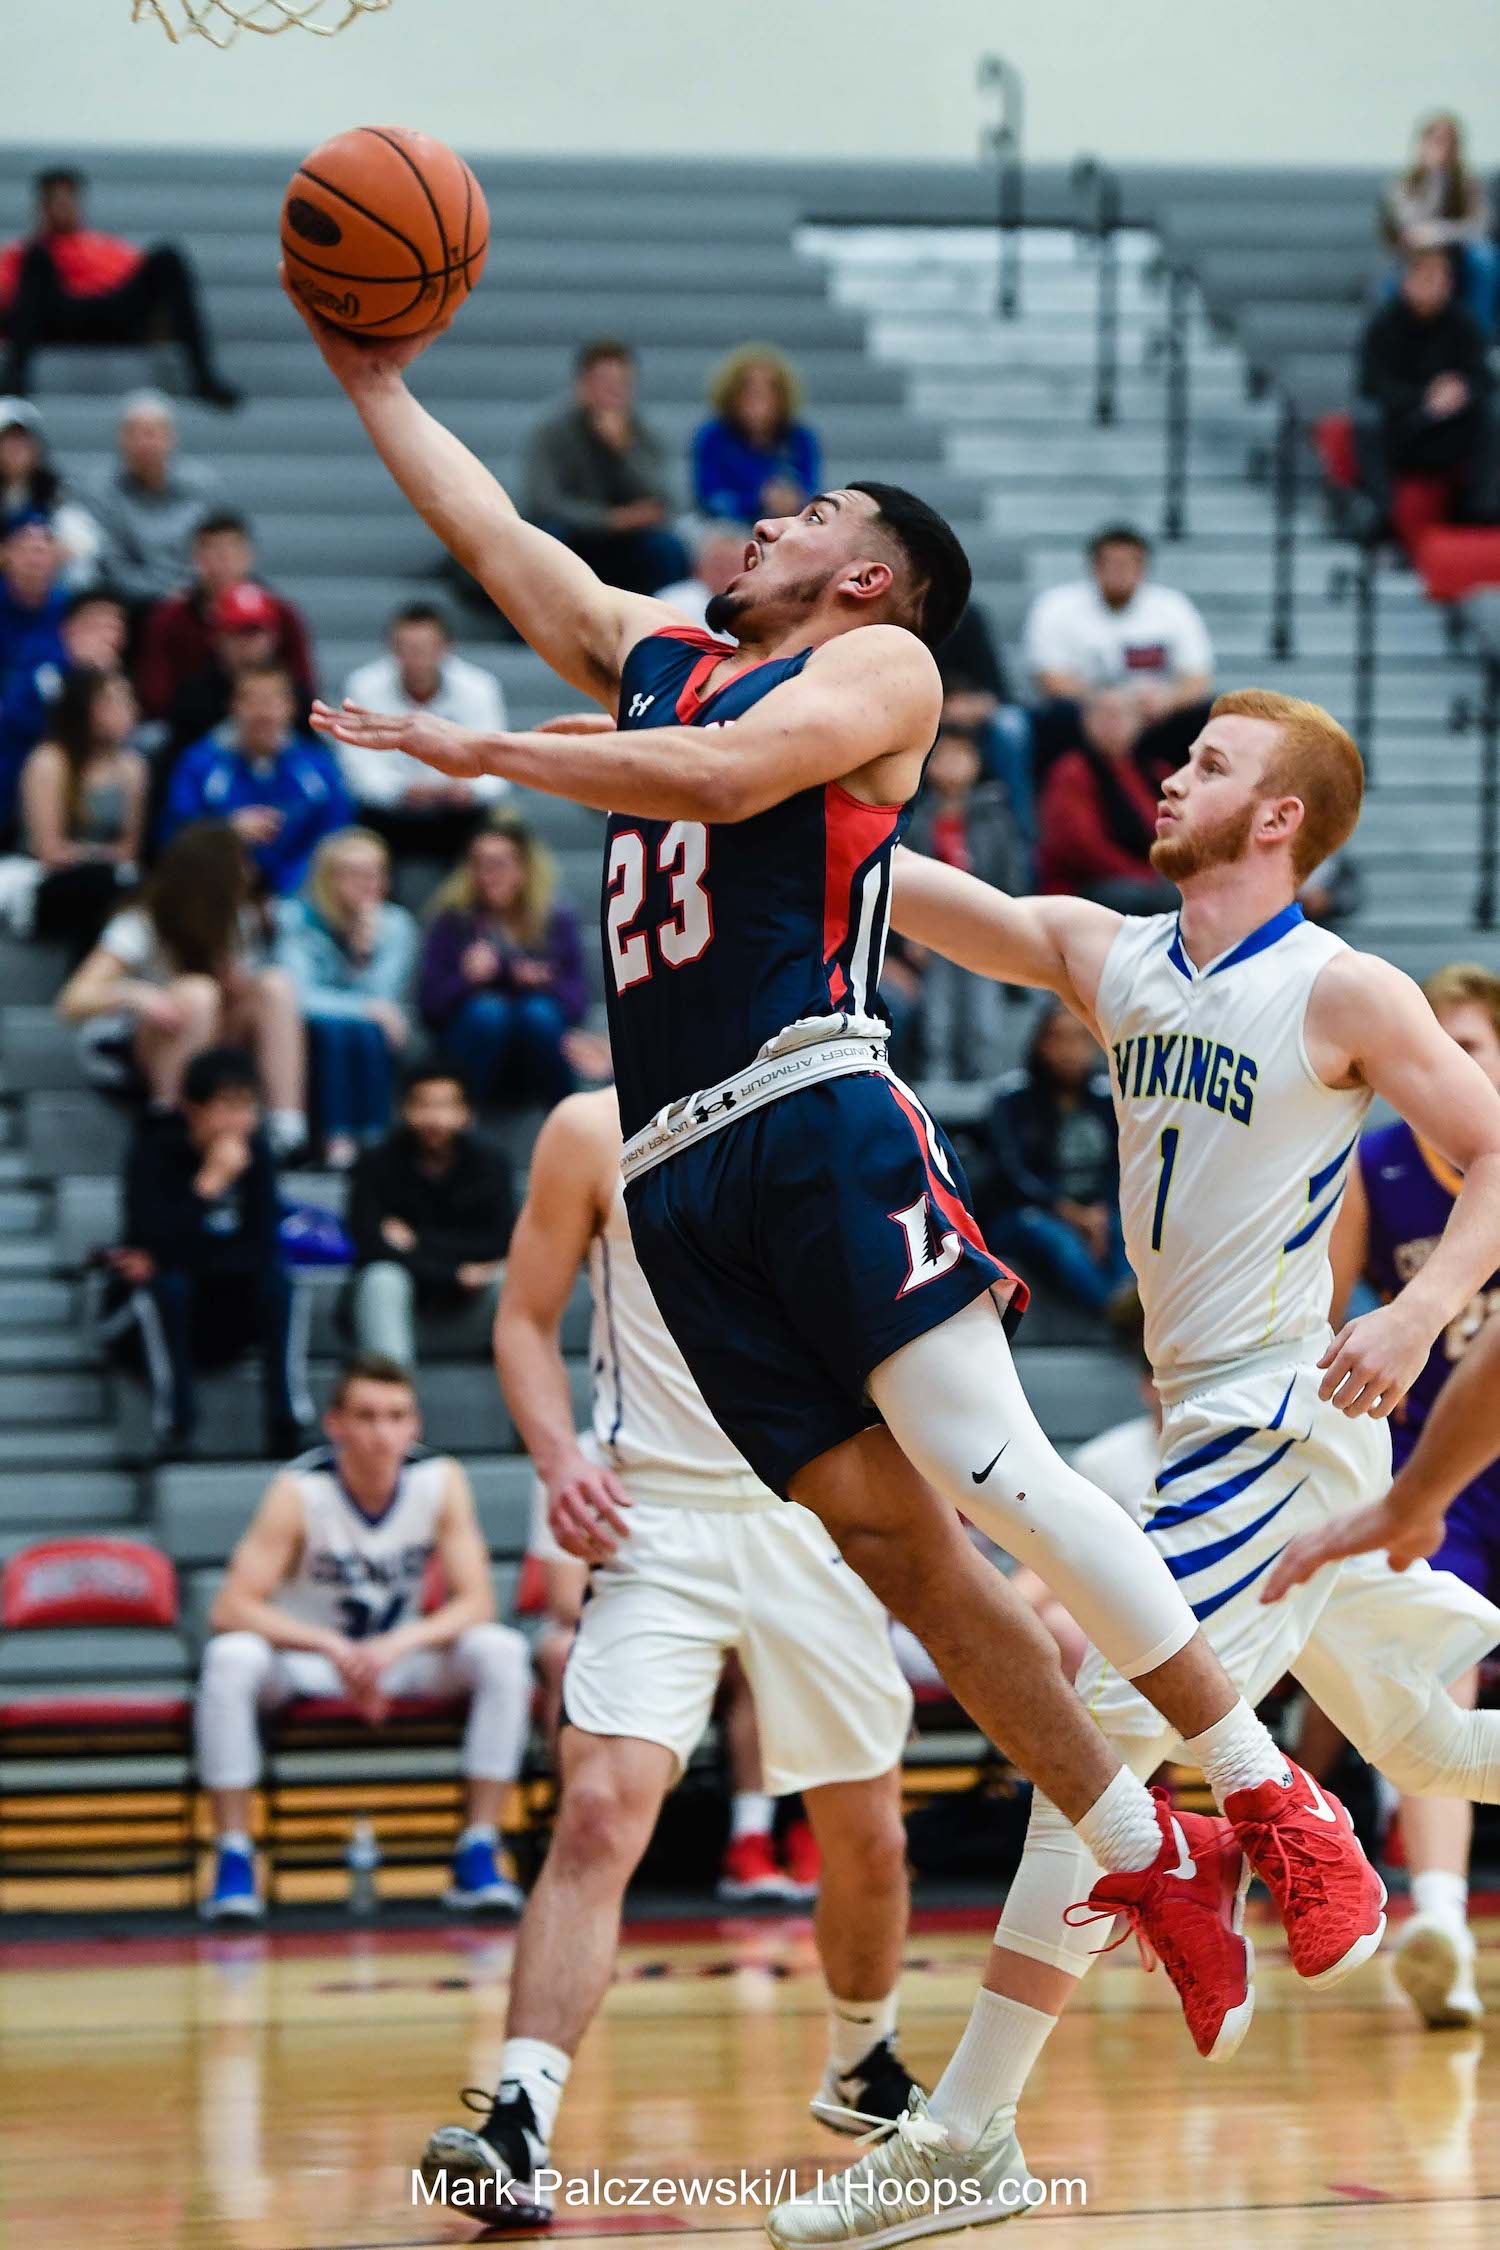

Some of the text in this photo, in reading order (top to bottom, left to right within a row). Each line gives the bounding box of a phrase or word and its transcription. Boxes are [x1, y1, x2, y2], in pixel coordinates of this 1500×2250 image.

[607, 820, 715, 998] 23
[740, 1045, 870, 1097] UNDER ARMOUR
[1112, 1033, 1259, 1128] VIKINGS
[1151, 1124, 1183, 1256] 1
[887, 1191, 965, 1301] L
